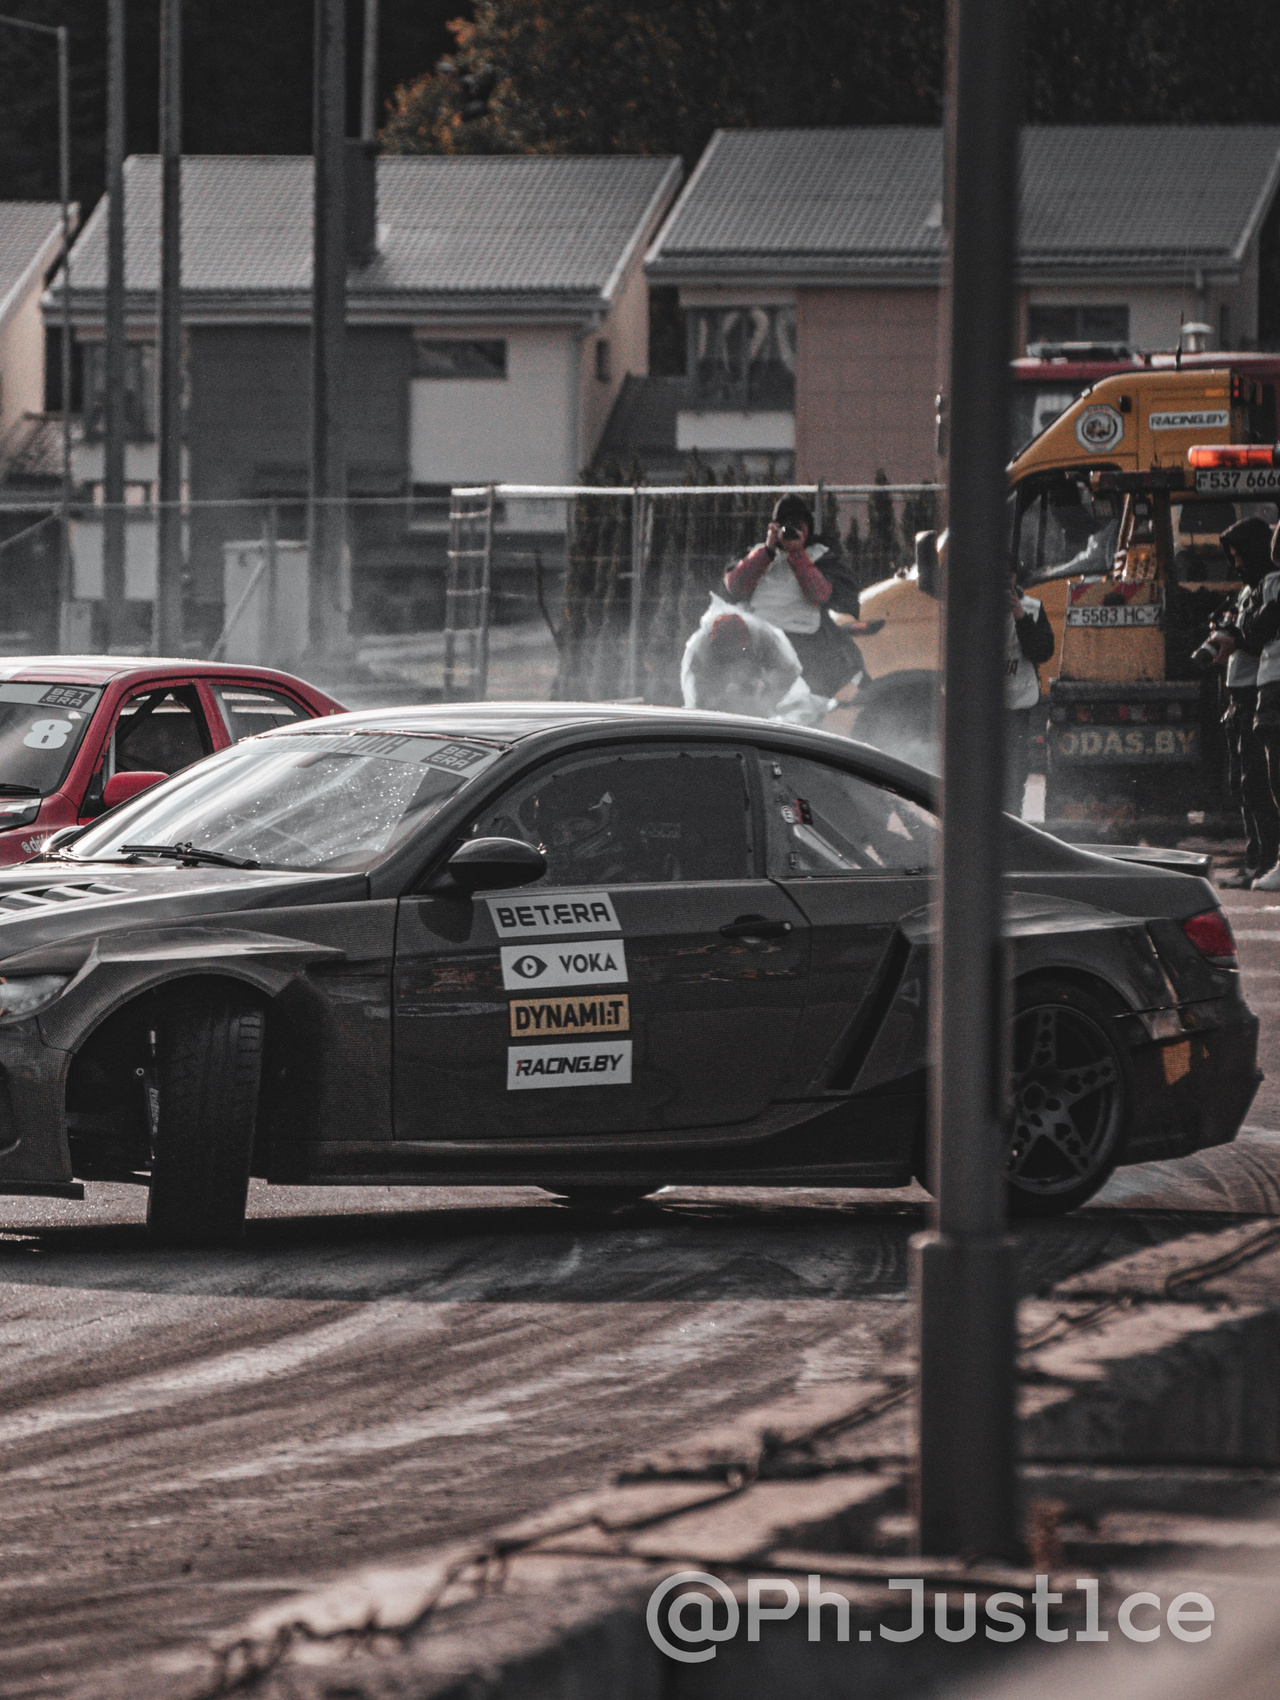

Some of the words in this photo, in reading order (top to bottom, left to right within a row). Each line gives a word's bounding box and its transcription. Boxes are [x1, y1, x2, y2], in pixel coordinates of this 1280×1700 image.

[1210, 471, 1241, 488] 537
[1246, 471, 1280, 488] 666
[1081, 608, 1118, 623] 5583
[50, 687, 90, 699] BET
[23, 719, 73, 749] 8
[441, 745, 483, 760] BET
[559, 953, 618, 974] VOKA
[516, 1054, 624, 1077] RACING.BY
